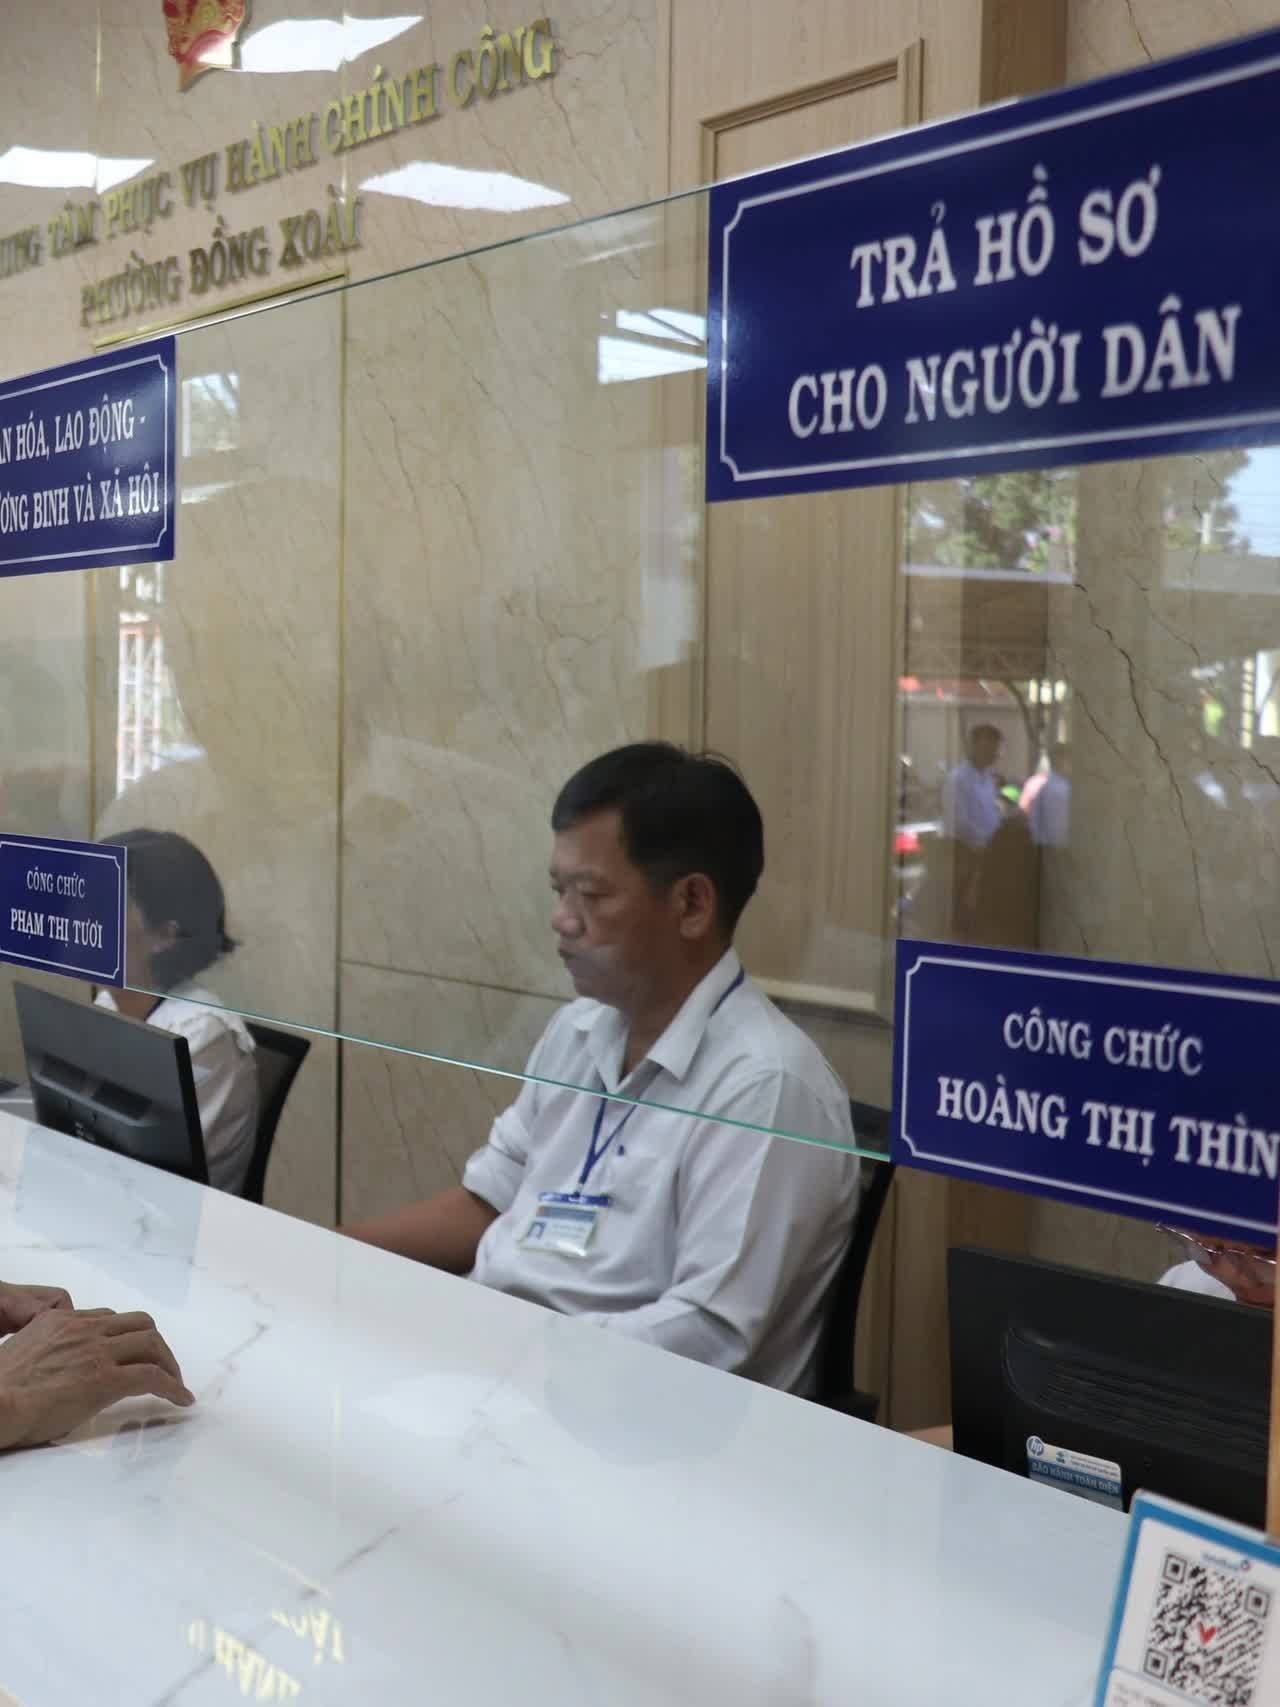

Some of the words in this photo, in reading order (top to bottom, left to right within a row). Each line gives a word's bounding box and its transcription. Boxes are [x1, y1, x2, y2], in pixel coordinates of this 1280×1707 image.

[48, 200, 98, 259] TÂM
[104, 172, 174, 239] PHỤC
[179, 152, 219, 211] VỤ
[225, 120, 318, 192] HÀNH
[322, 64, 440, 155] CHÍNH
[448, 17, 558, 108] CÔNG
[80, 250, 181, 327] PHƯỜNG
[188, 214, 269, 294] ĐỒNG
[279, 184, 363, 267] XOÀI
[850, 202, 957, 308] TRẢ
[973, 163, 1055, 286] HỒ
[1077, 163, 1162, 266] SƠ
[787, 364, 887, 439] CHO
[904, 318, 1081, 424] NGƯỜI
[1100, 293, 1242, 399] DÂN
[16, 411, 50, 461] HÓA,
[55, 409, 84, 454] LAO
[89, 394, 134, 454] ĐỘNG
[33, 487, 70, 530] BINH
[73, 471, 95, 524] VÀ
[100, 466, 124, 521] XÃ
[27, 866, 53, 893] CÔNG
[57, 871, 86, 899] CHỨC
[10, 908, 44, 940] PHẠM
[48, 915, 69, 948] THỊ
[73, 918, 103, 949] TƯƠI
[1003, 1006, 1092, 1061] CÔNG
[1103, 1021, 1203, 1076] CHỨC
[936, 1073, 1069, 1140] HOÀNG
[1081, 1100, 1156, 1168] THỊ
[1028, 1438, 1044, 1456] hp
